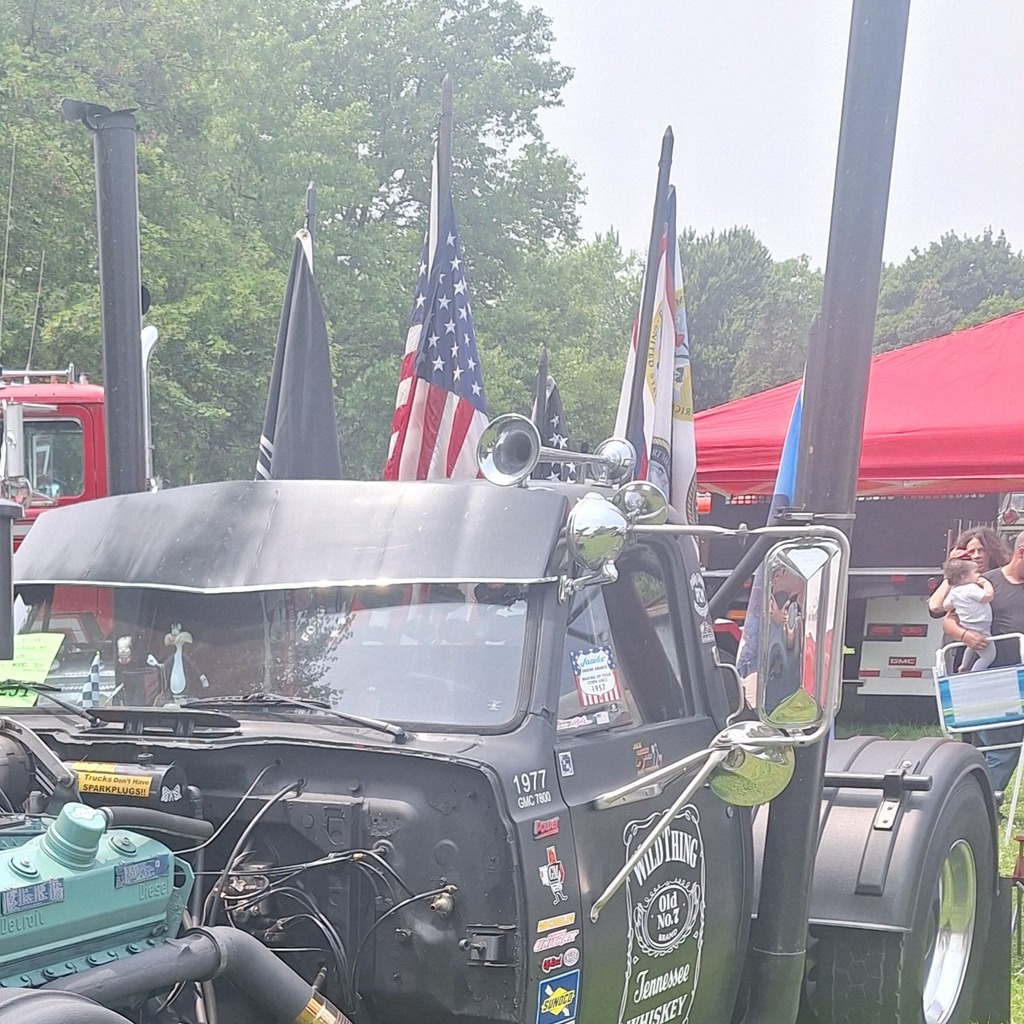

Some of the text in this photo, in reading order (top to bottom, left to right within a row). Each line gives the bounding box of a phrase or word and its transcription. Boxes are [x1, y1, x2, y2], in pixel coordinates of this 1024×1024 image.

[591, 684, 606, 692] 1957
[83, 783, 147, 796] SPARKPLUGS!!
[84, 773, 112, 783] Trucks
[133, 778, 149, 786] Have
[513, 769, 547, 795] 1977
[517, 791, 551, 809] GMC 7800
[633, 824, 699, 887] WILD THING
[139, 879, 170, 900] Diesel
[658, 891, 678, 913] Old
[0, 910, 46, 936] Detroit
[658, 929, 679, 942] BRAND
[634, 963, 690, 1003] Tennessee
[542, 992, 574, 1012] SUNOCO
